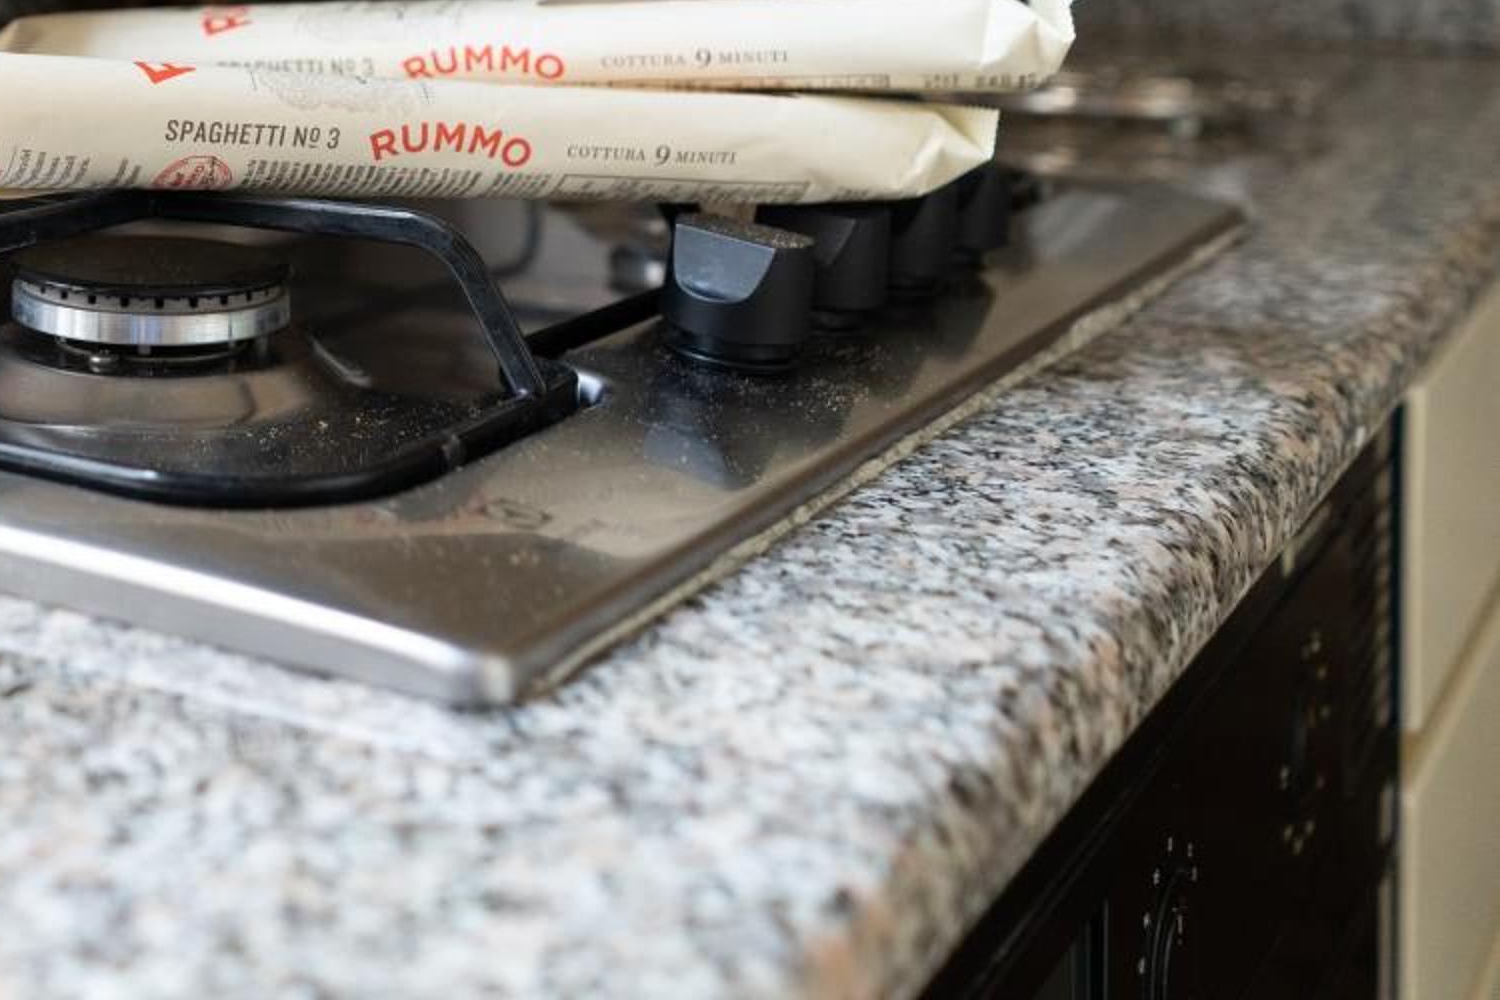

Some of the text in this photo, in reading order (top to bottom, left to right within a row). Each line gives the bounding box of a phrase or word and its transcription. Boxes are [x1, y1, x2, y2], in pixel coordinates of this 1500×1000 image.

[403, 44, 564, 80] RUMMO
[600, 48, 789, 68] COTTURA 9 MINUTI
[165, 119, 287, 147] SPAGHETTI
[326, 128, 342, 150] 3
[370, 122, 532, 167] RUMMO
[566, 144, 738, 167] COTTURA 9 MINUTI
